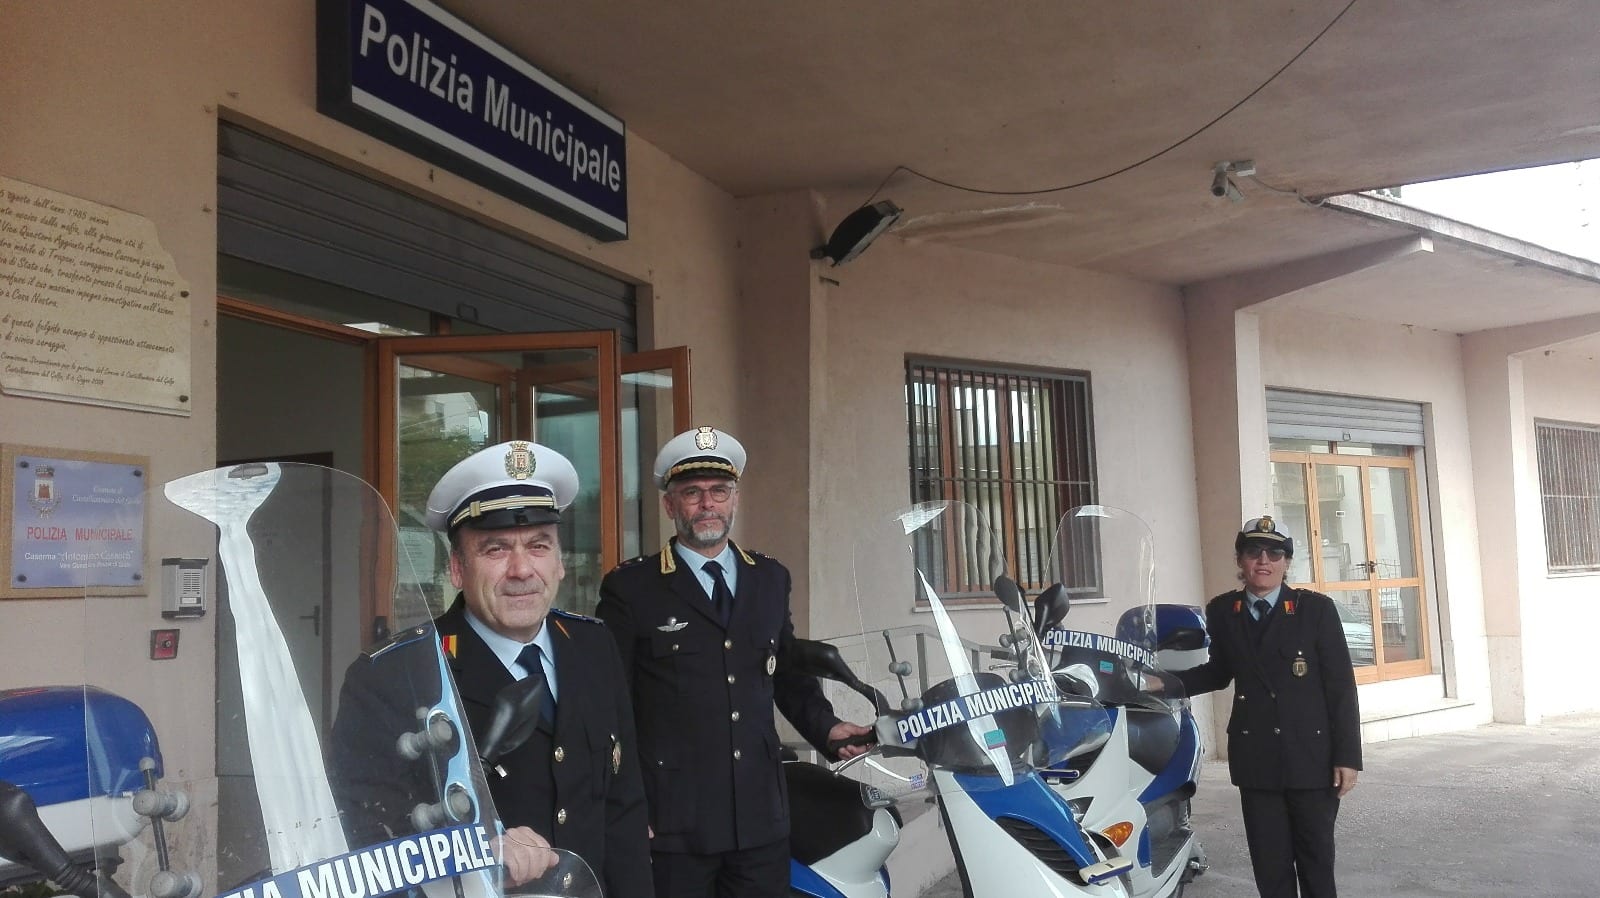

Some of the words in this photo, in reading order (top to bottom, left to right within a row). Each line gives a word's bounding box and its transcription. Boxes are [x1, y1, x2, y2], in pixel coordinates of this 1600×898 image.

[360, 3, 474, 114] Polizia
[484, 75, 621, 193] Municipale
[68, 208, 87, 220] 1985
[26, 526, 68, 541] POLIZIA
[75, 527, 133, 541] MUNICIPALE
[24, 551, 57, 561] Caserma
[1045, 630, 1093, 649] POLIZIA
[1096, 635, 1154, 670] MUNICIPALE
[897, 701, 965, 744] POLIZIA
[965, 682, 1054, 719] MUNICIPALE
[297, 826, 495, 898] MUNICIPALE
